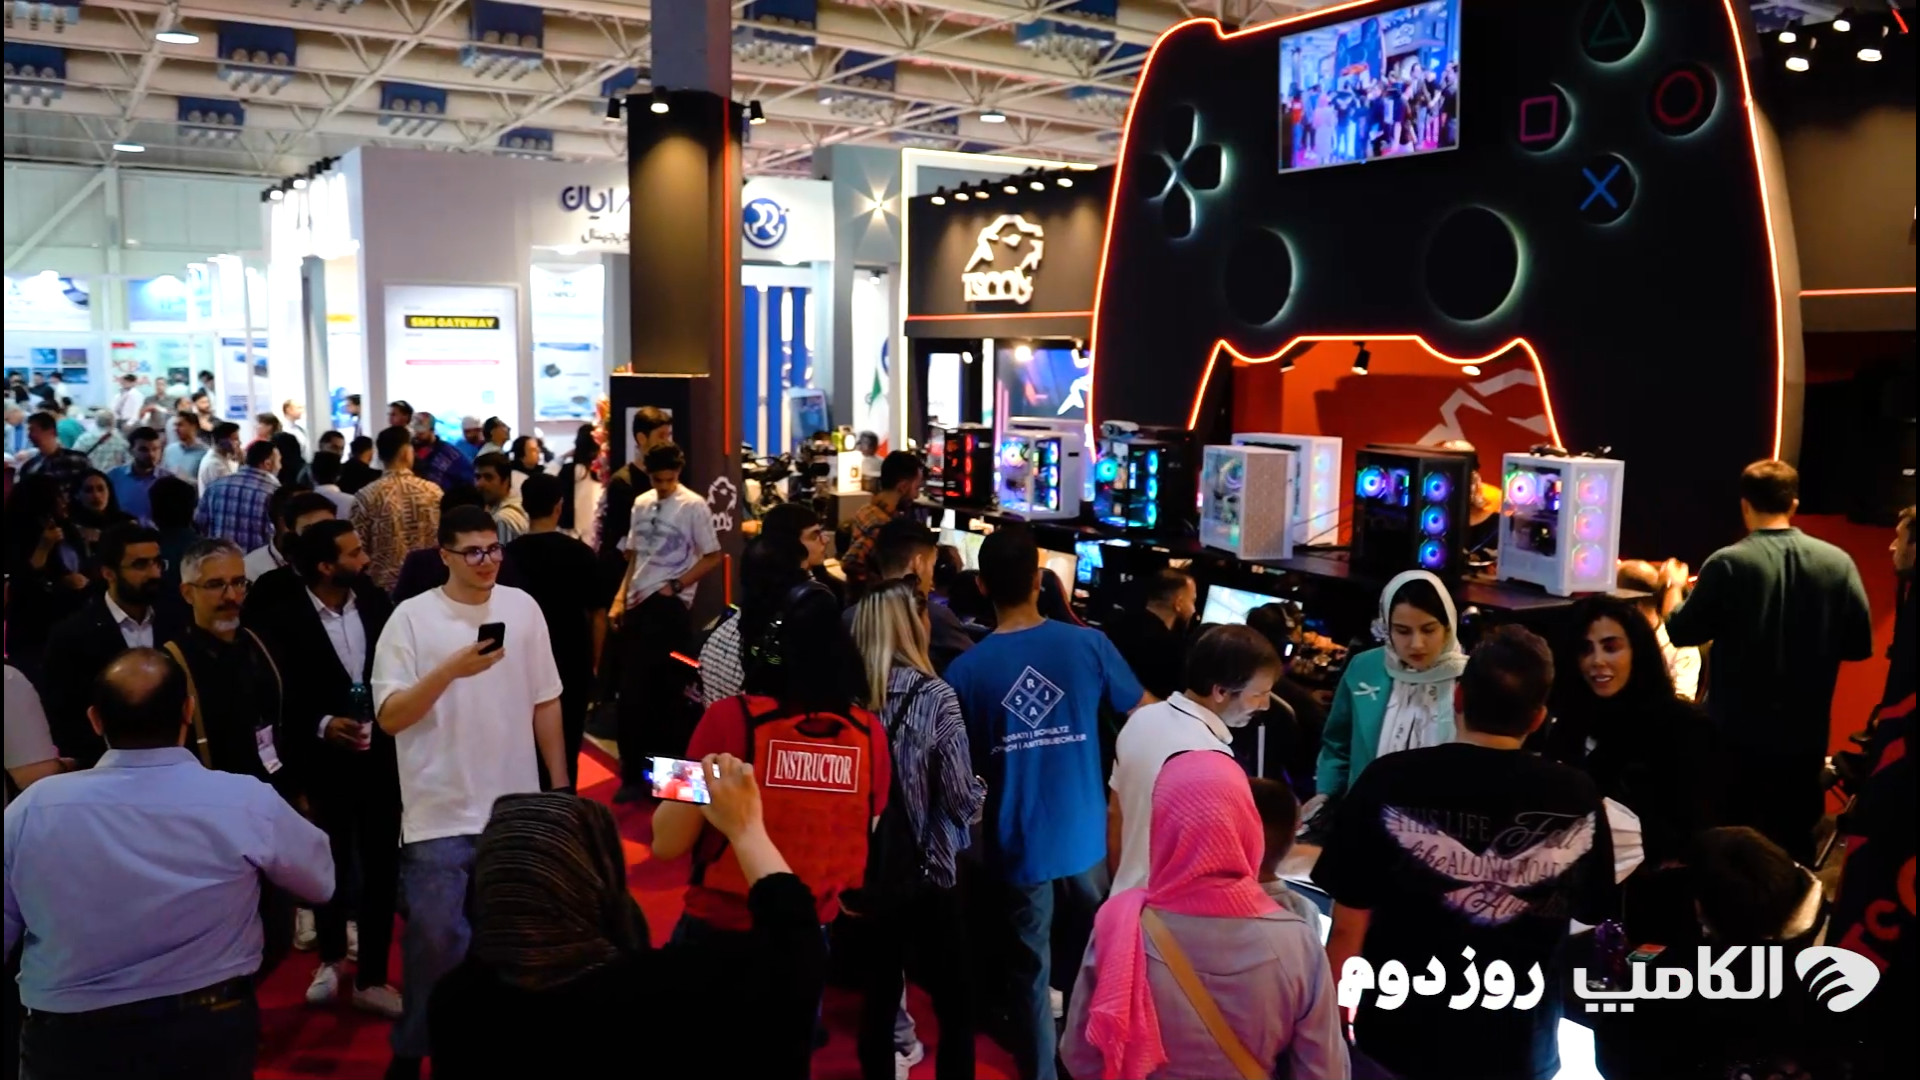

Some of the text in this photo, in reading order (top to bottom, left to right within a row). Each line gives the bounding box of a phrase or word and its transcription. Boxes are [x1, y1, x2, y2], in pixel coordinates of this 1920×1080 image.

[410, 317, 496, 329] SMS GATEWAY
[1026, 678, 1036, 689] R
[1014, 695, 1023, 706] S
[1028, 706, 1039, 717] A
[773, 749, 853, 785] INSTRUCTOR
[1445, 810, 1491, 842] LIFE
